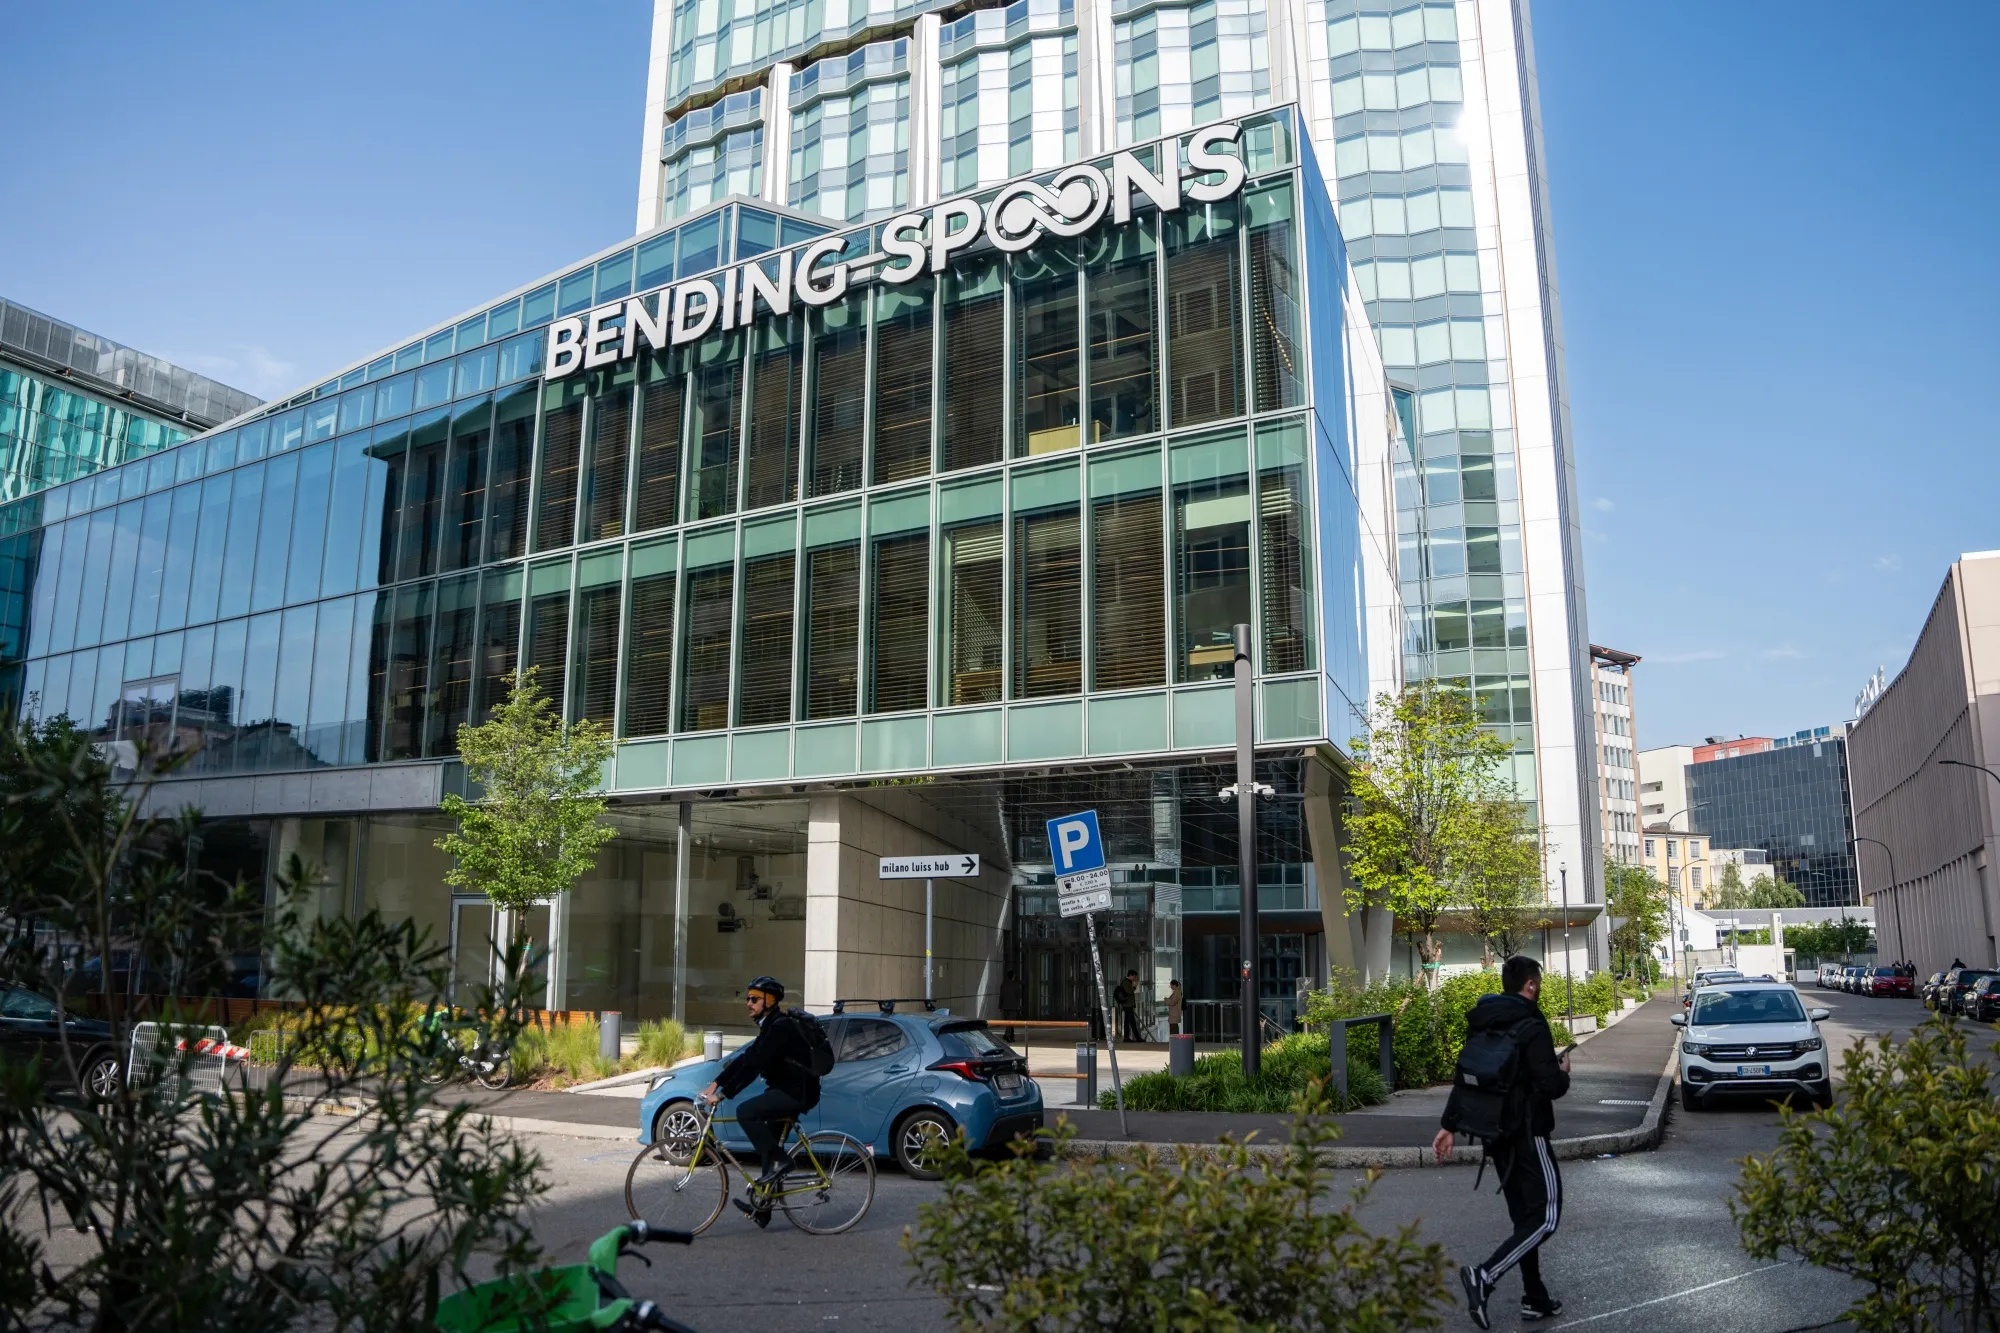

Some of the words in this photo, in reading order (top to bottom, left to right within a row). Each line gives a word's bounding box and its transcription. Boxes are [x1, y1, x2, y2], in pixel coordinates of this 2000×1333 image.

[545, 237, 849, 381] BENDING
[880, 124, 1247, 285] SPOONS
[881, 862, 909, 873] milano
[911, 861, 932, 872] luiss
[934, 860, 950, 871] hub
[1057, 820, 1090, 869] P
